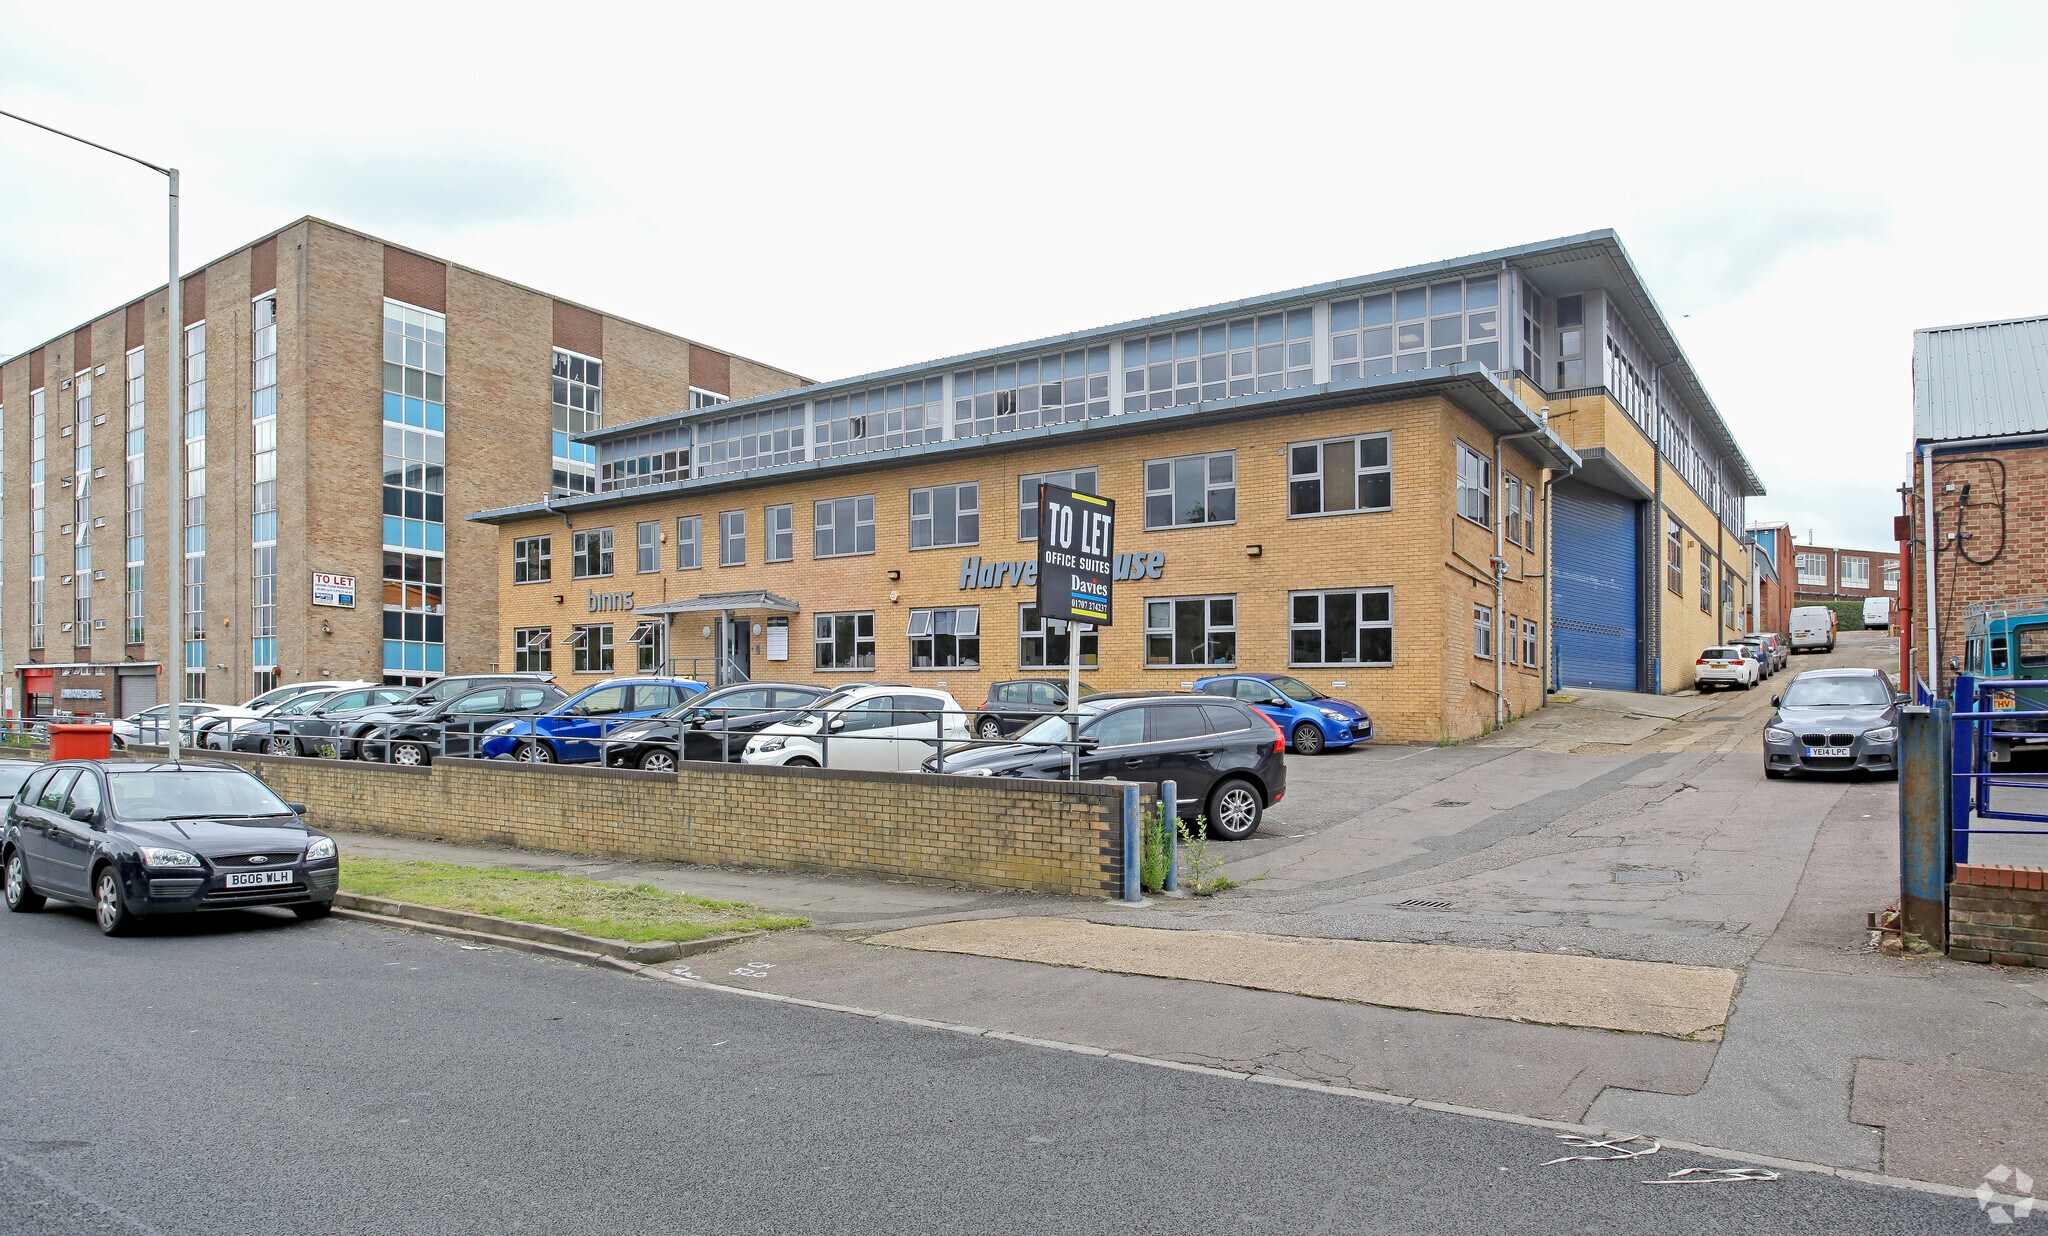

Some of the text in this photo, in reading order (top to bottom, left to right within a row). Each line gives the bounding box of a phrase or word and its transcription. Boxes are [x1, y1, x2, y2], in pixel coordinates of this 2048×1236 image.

[1049, 501, 1112, 557] TO LET
[959, 551, 1165, 590] Harve use
[1045, 550, 1110, 575] OFFICE SUITES
[316, 574, 353, 586] TO LET
[1071, 574, 1108, 597] Davies
[587, 588, 634, 612] binns
[1071, 598, 1108, 613] 01707 274237
[1813, 748, 1847, 756] YE14 LPC
[232, 872, 288, 885] BG06 WLH
